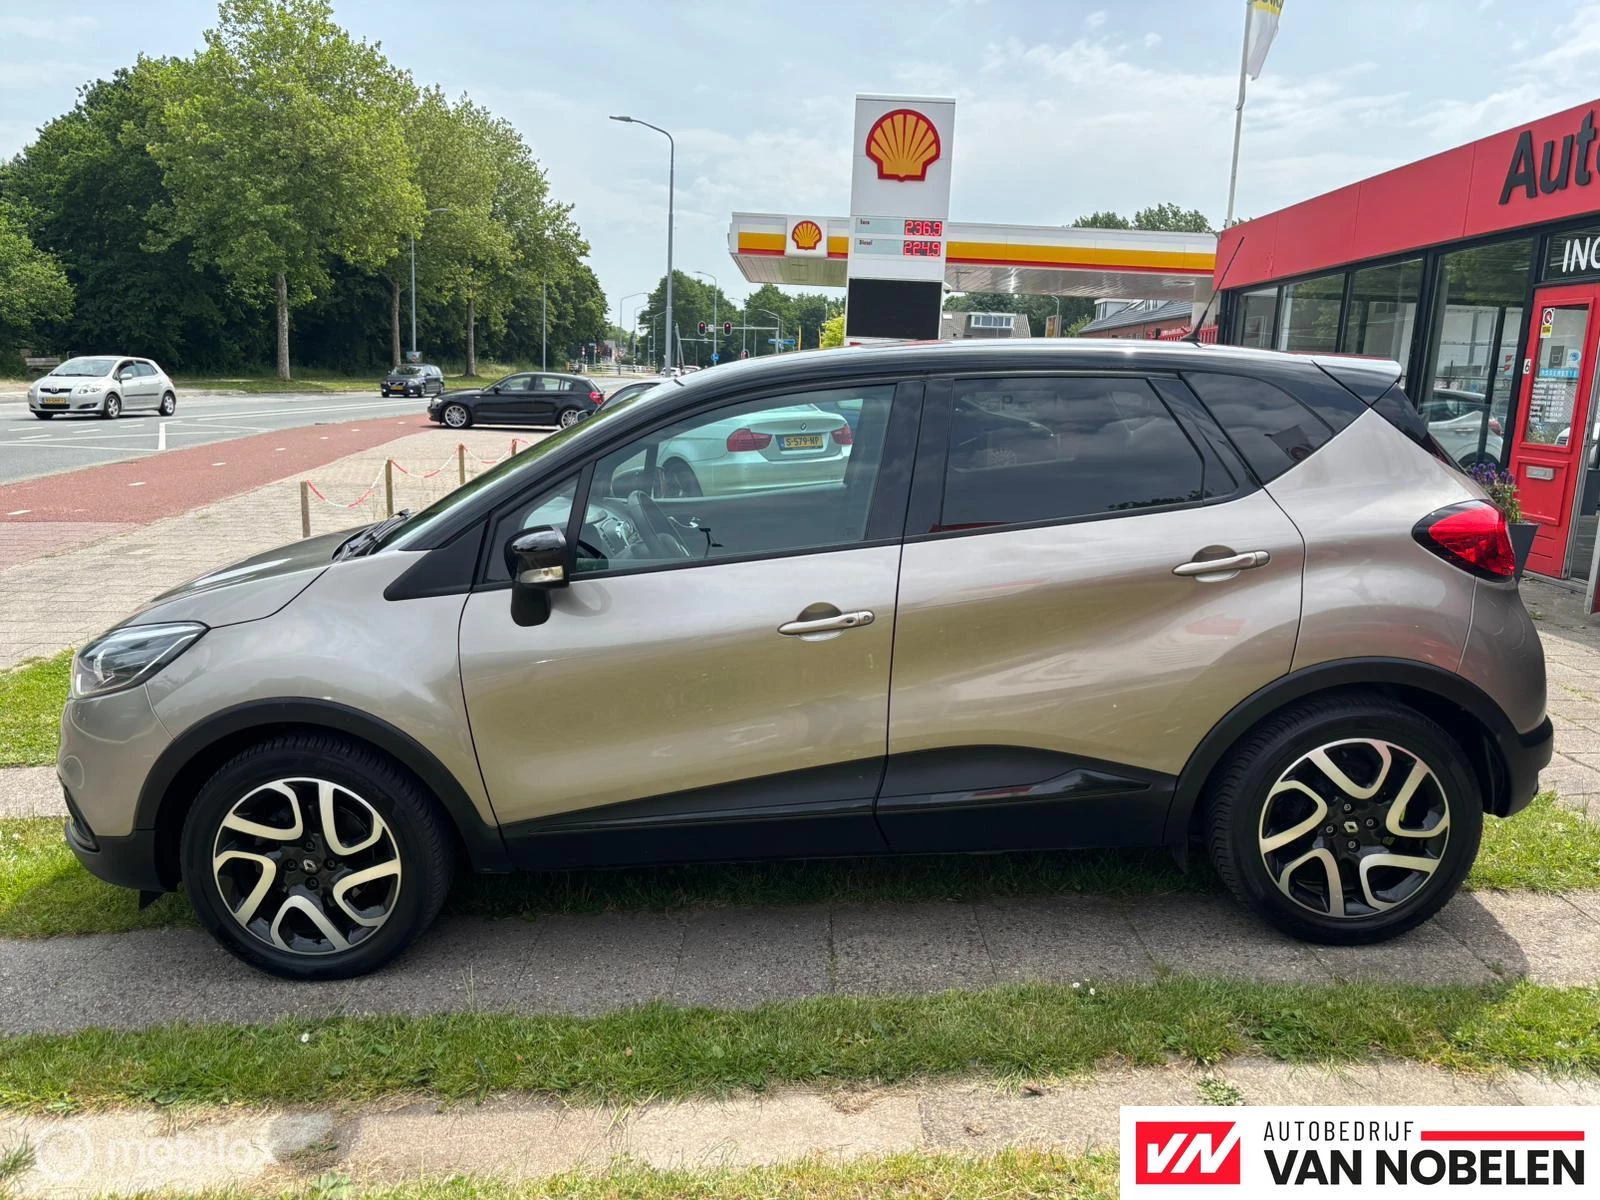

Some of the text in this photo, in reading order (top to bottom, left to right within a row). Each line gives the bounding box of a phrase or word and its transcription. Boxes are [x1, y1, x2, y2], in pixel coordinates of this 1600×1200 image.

[1498, 109, 1600, 206] Aut
[905, 220, 942, 236] 236.9
[903, 241, 941, 256] 224.9
